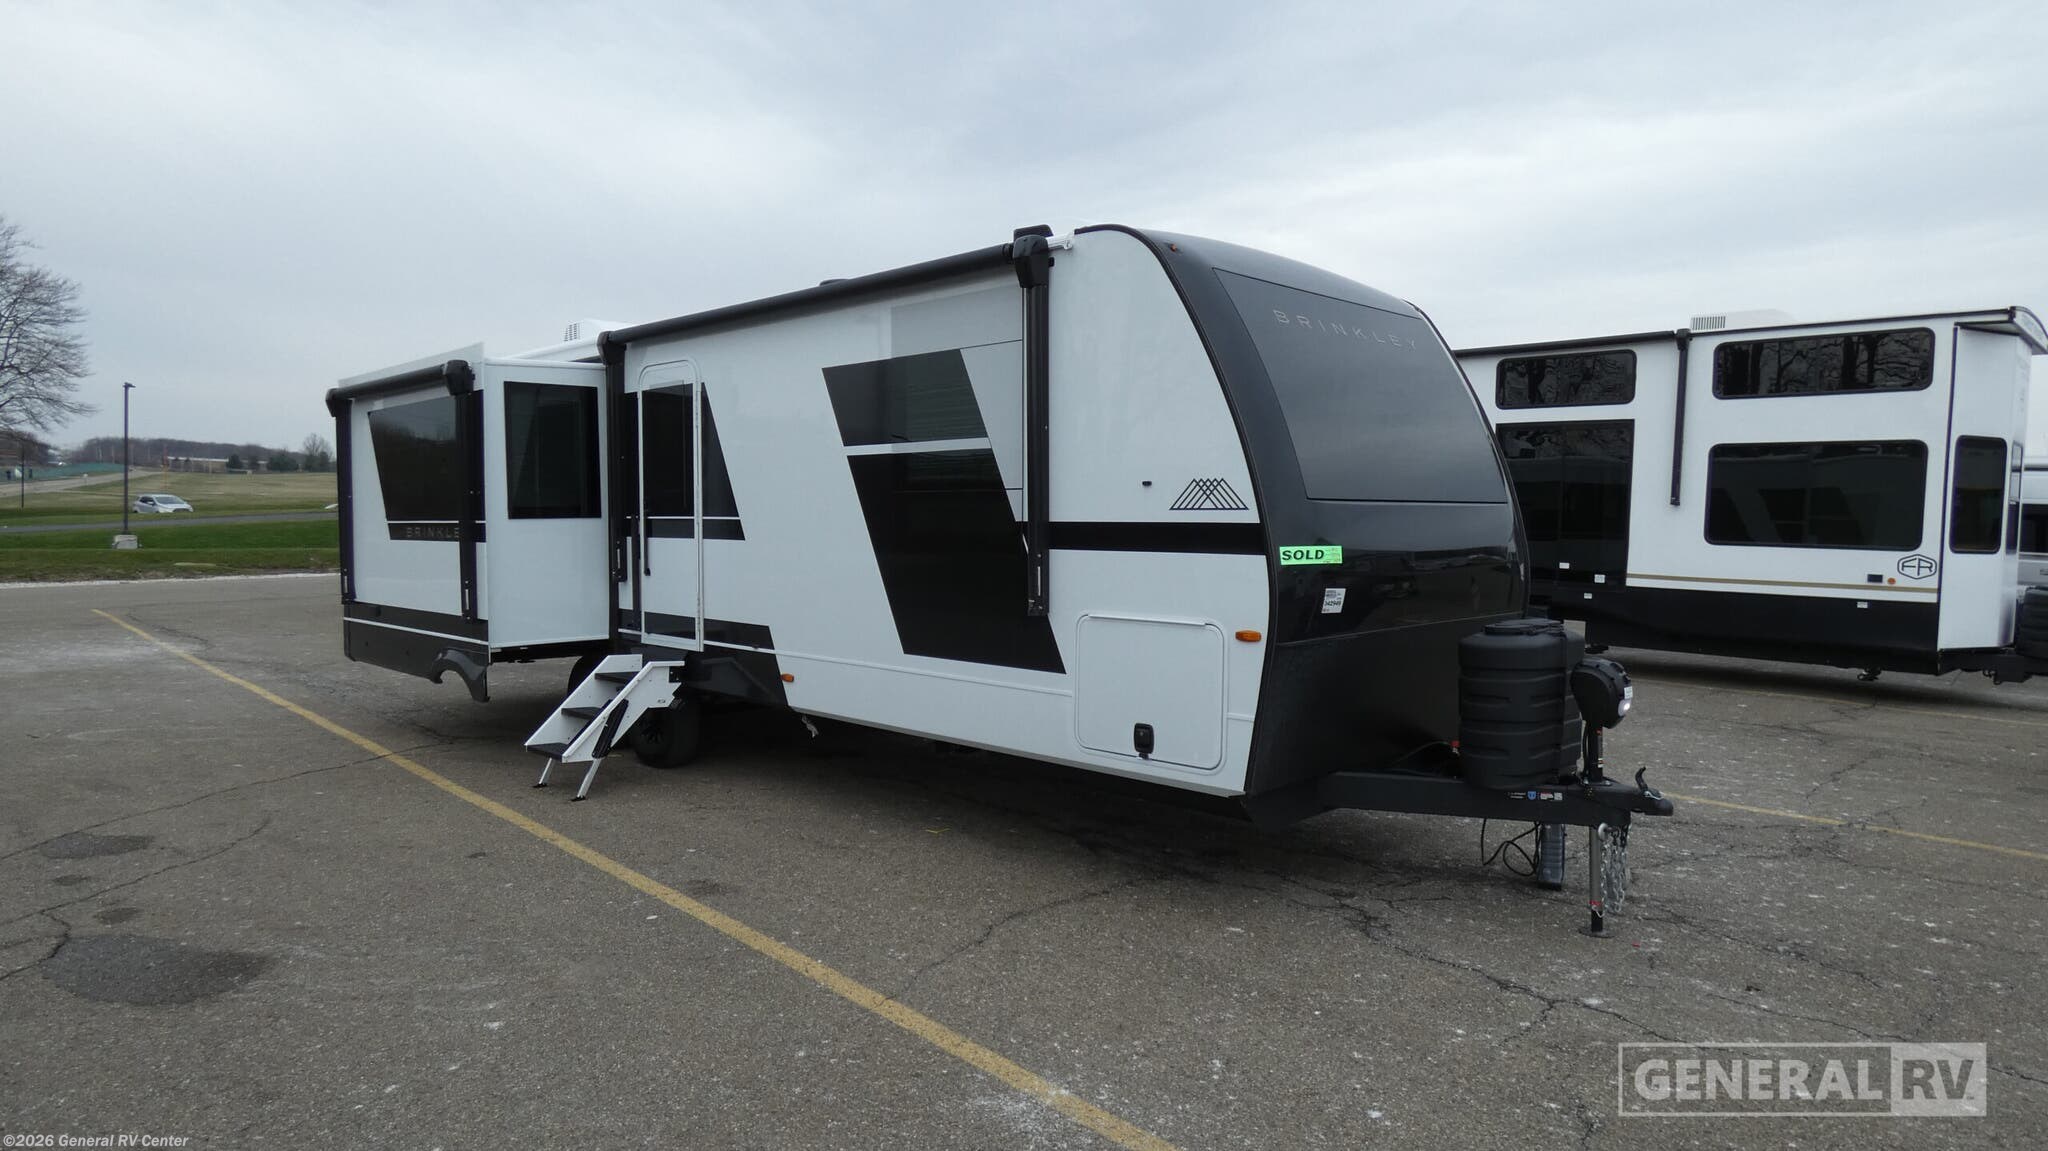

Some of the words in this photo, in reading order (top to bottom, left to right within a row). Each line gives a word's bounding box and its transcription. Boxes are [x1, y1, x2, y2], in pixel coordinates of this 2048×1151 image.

[1272, 309, 1416, 350] BRINKLEY
[1282, 549, 1325, 561] SOLD
[1901, 557, 1933, 576] FR
